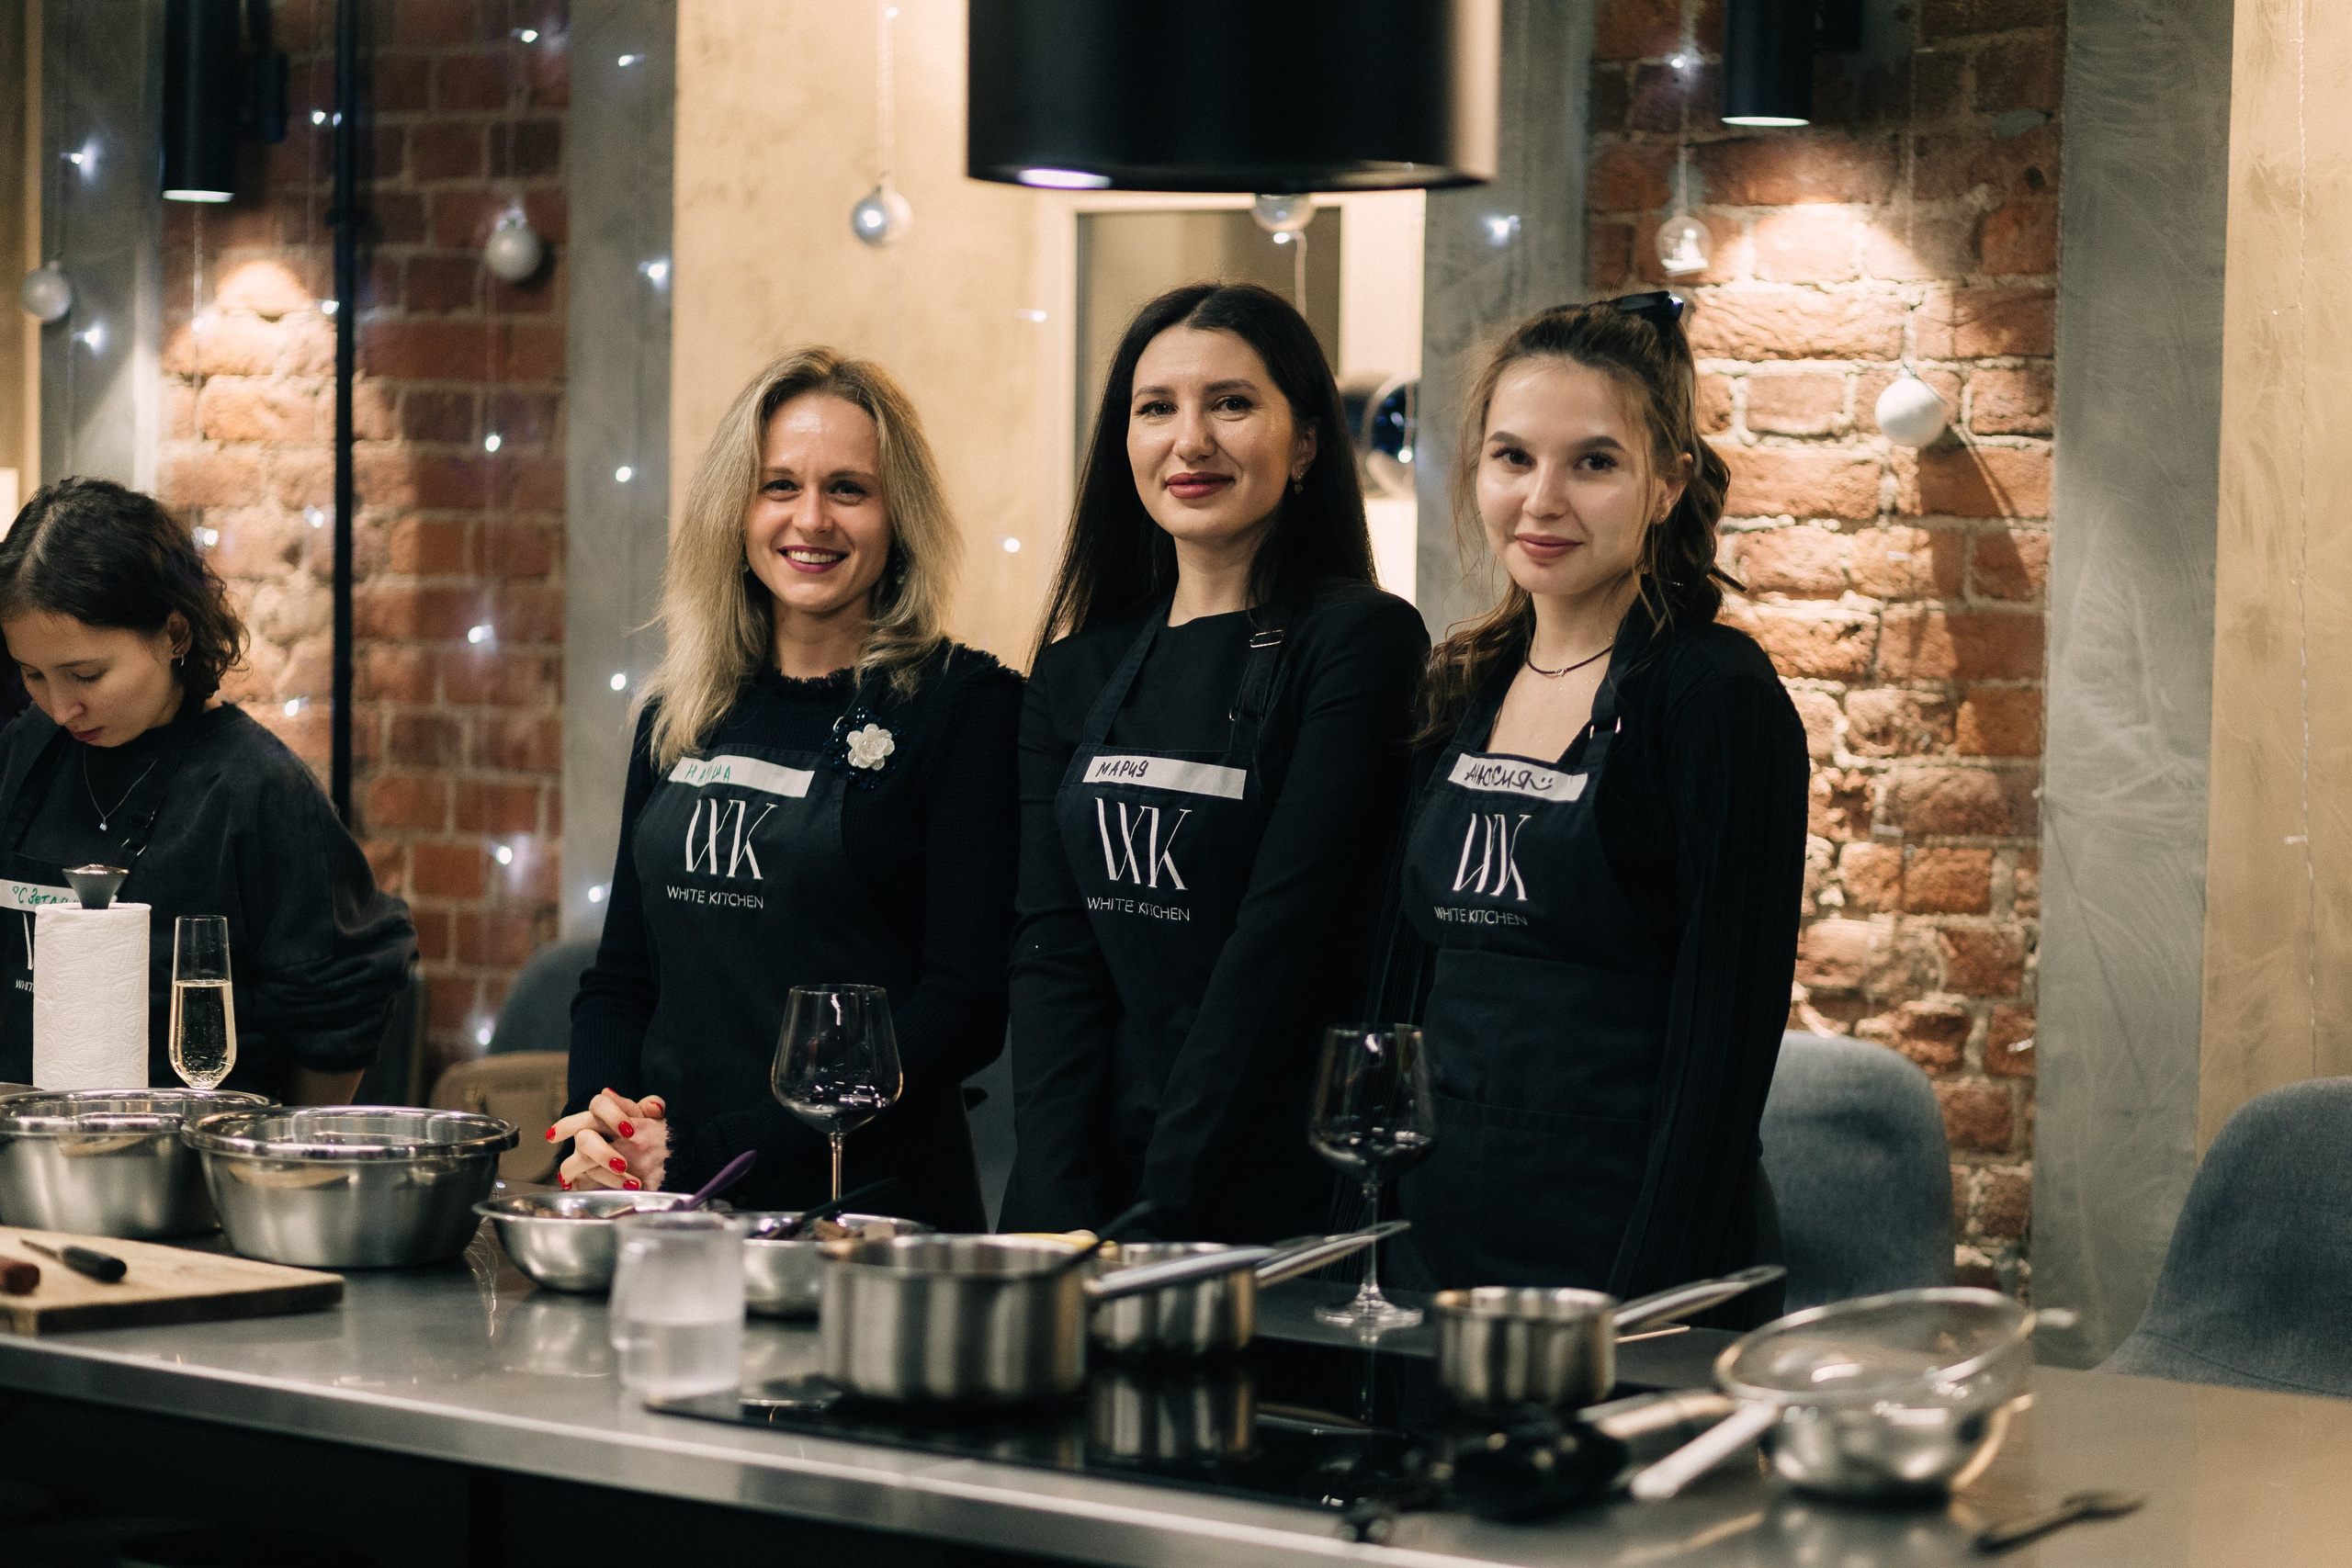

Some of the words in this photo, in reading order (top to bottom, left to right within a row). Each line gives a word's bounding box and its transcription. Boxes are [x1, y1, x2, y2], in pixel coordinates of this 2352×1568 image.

[1095, 760, 1149, 778] МАРИЯ
[685, 797, 778, 880] WK
[1094, 796, 1193, 890] WK
[667, 885, 706, 904] WHITE
[708, 891, 763, 909] KITCHEN
[1087, 897, 1134, 913] WHITE
[1137, 901, 1191, 921] KITCHEN
[1434, 906, 1466, 922] WHITE
[1468, 909, 1528, 926] KITCHEN
[15, 978, 34, 992] WHIT
